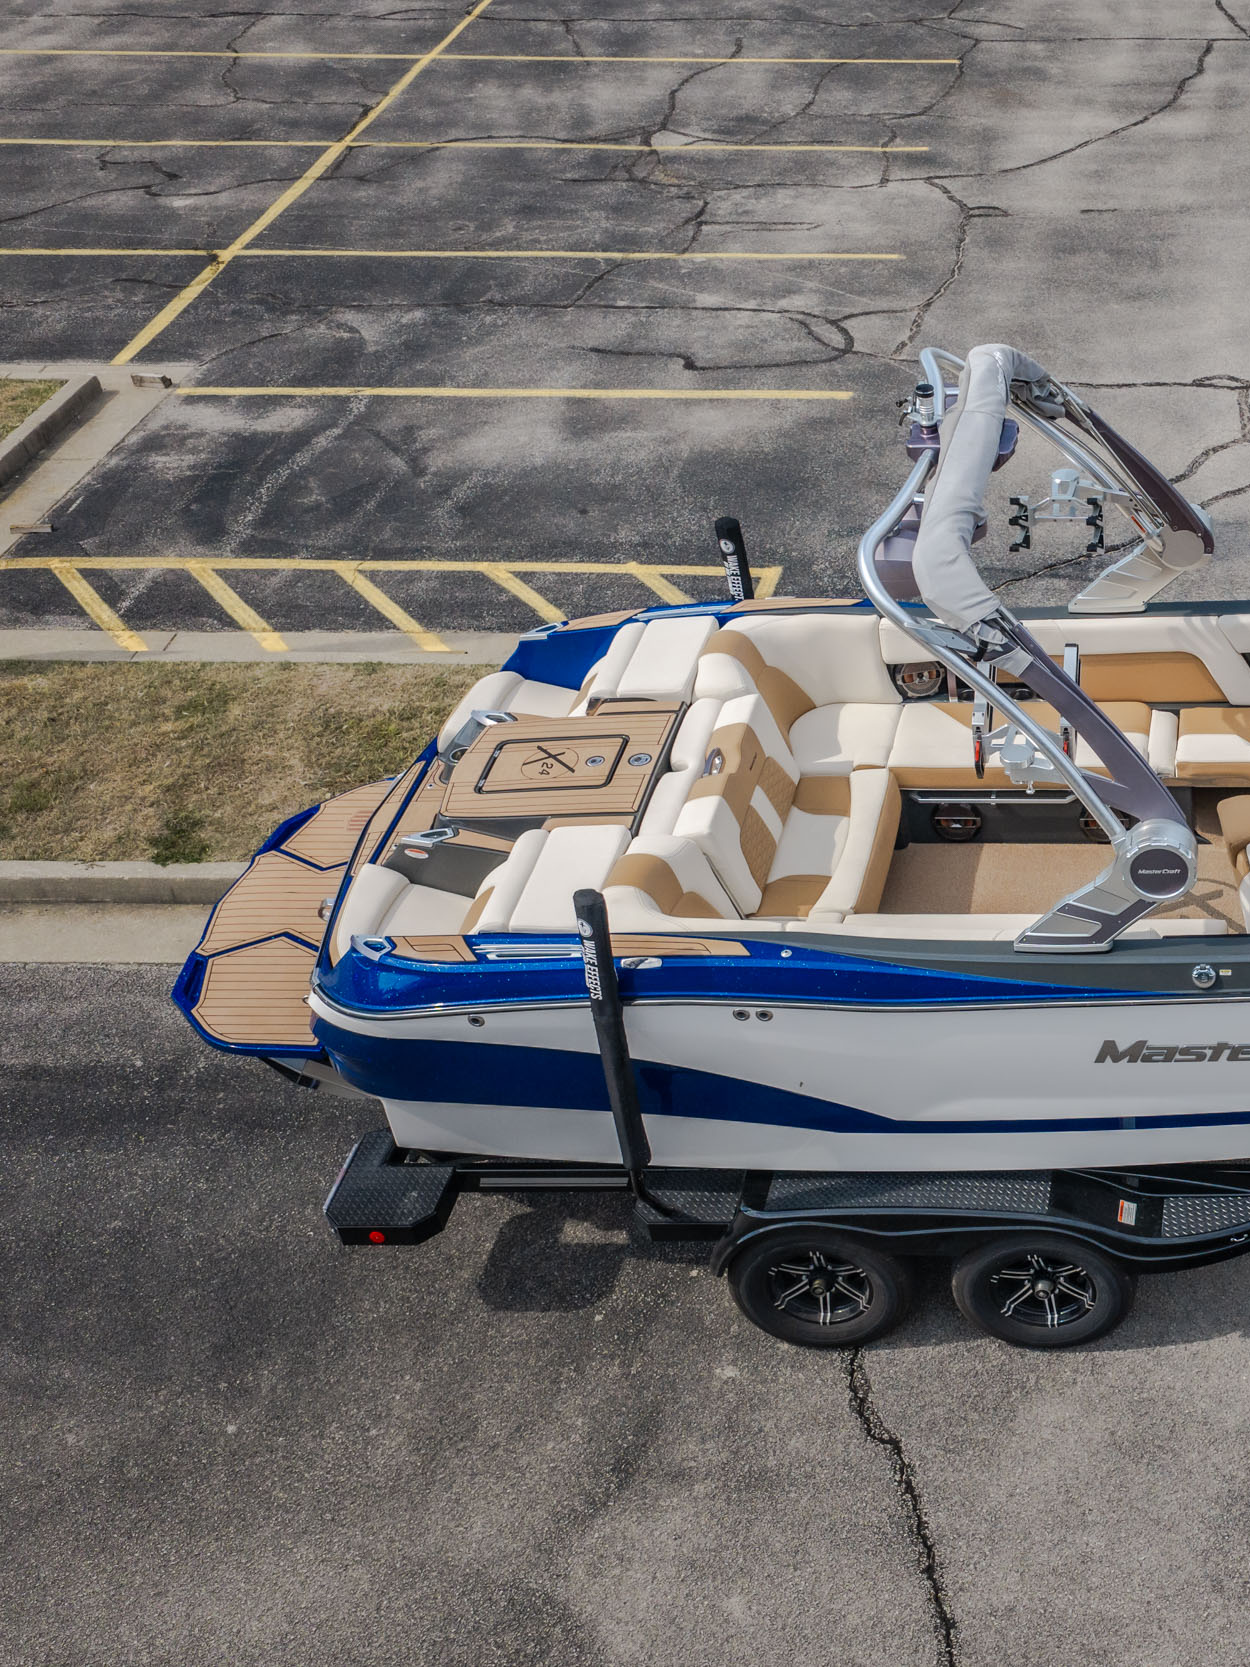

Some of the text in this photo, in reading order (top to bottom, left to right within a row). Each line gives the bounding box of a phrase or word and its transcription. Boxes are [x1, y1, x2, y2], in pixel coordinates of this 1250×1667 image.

[727, 555, 740, 576] WAKE
[731, 576, 744, 600] EFFECT
[583, 940, 597, 965] WAKE
[586, 965, 602, 1000] EFFECTS
